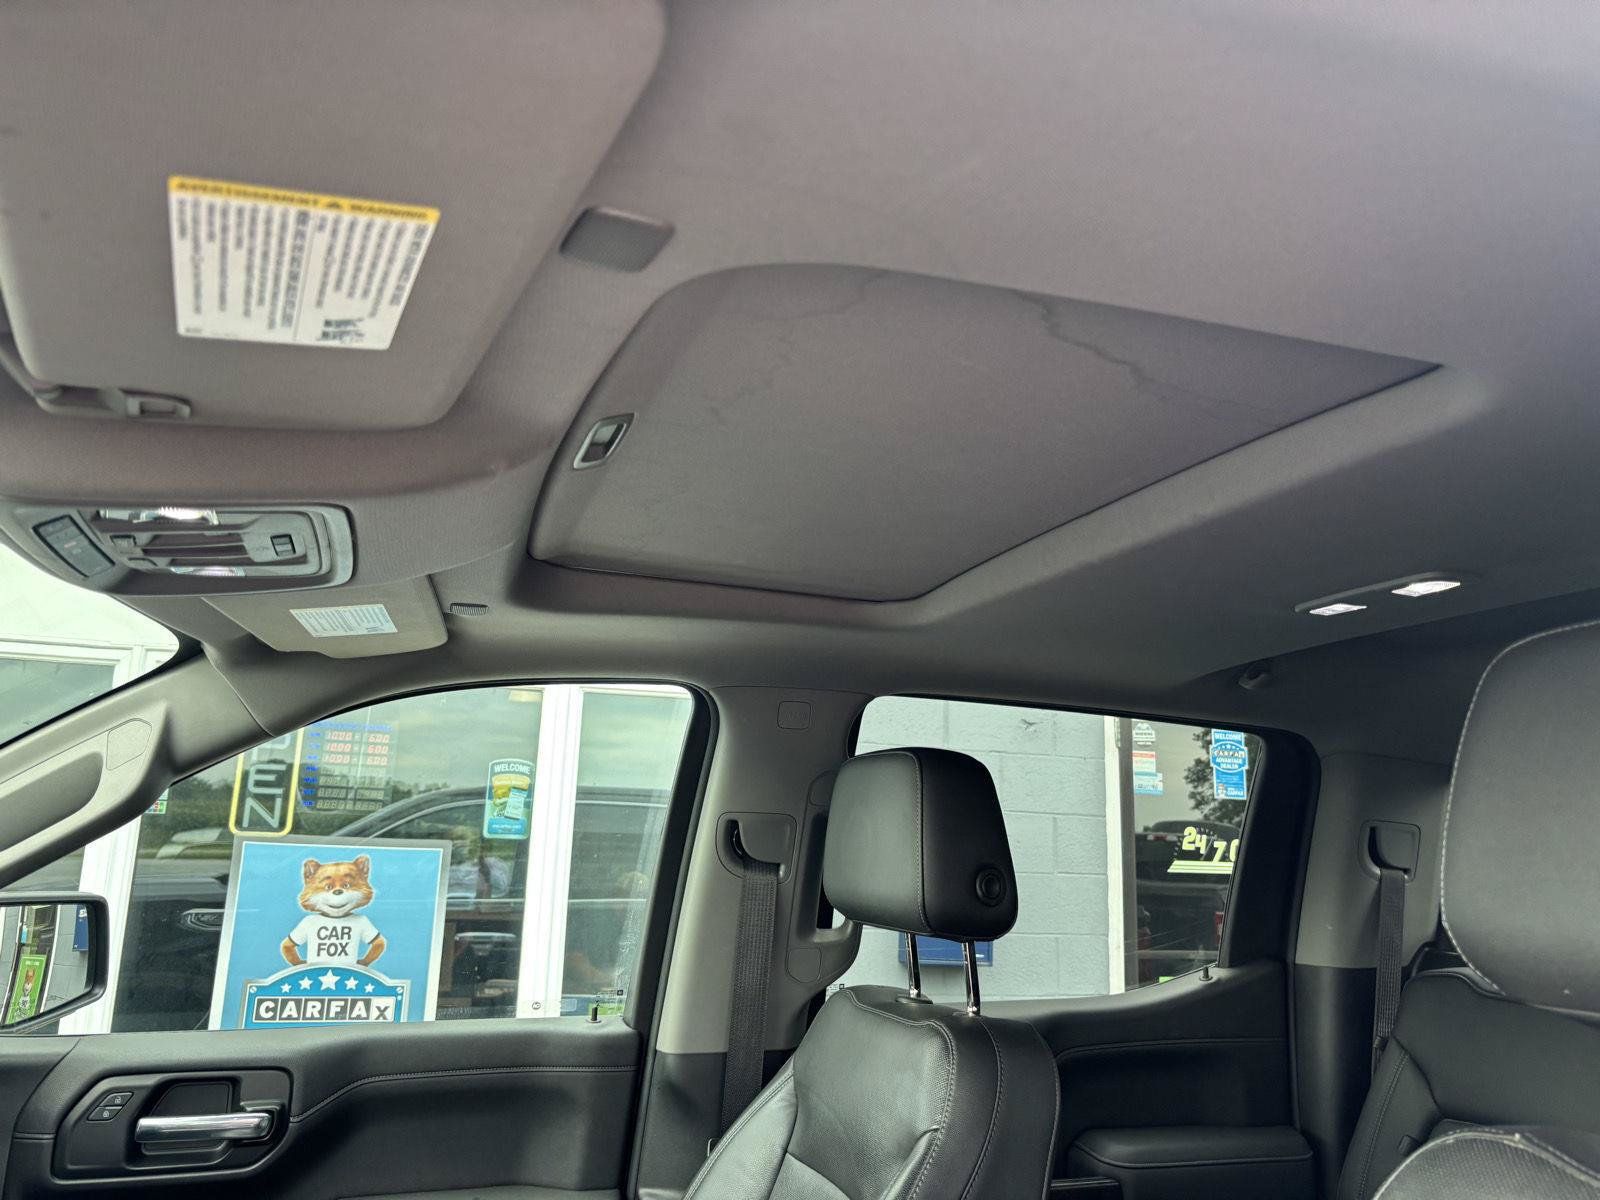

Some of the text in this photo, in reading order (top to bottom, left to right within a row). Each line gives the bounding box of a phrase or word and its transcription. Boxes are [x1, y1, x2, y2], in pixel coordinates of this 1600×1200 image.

[494, 763, 531, 775] WELCOME
[316, 925, 353, 941] CAR
[316, 942, 349, 957] FOX
[259, 999, 390, 1021] CARFAX
